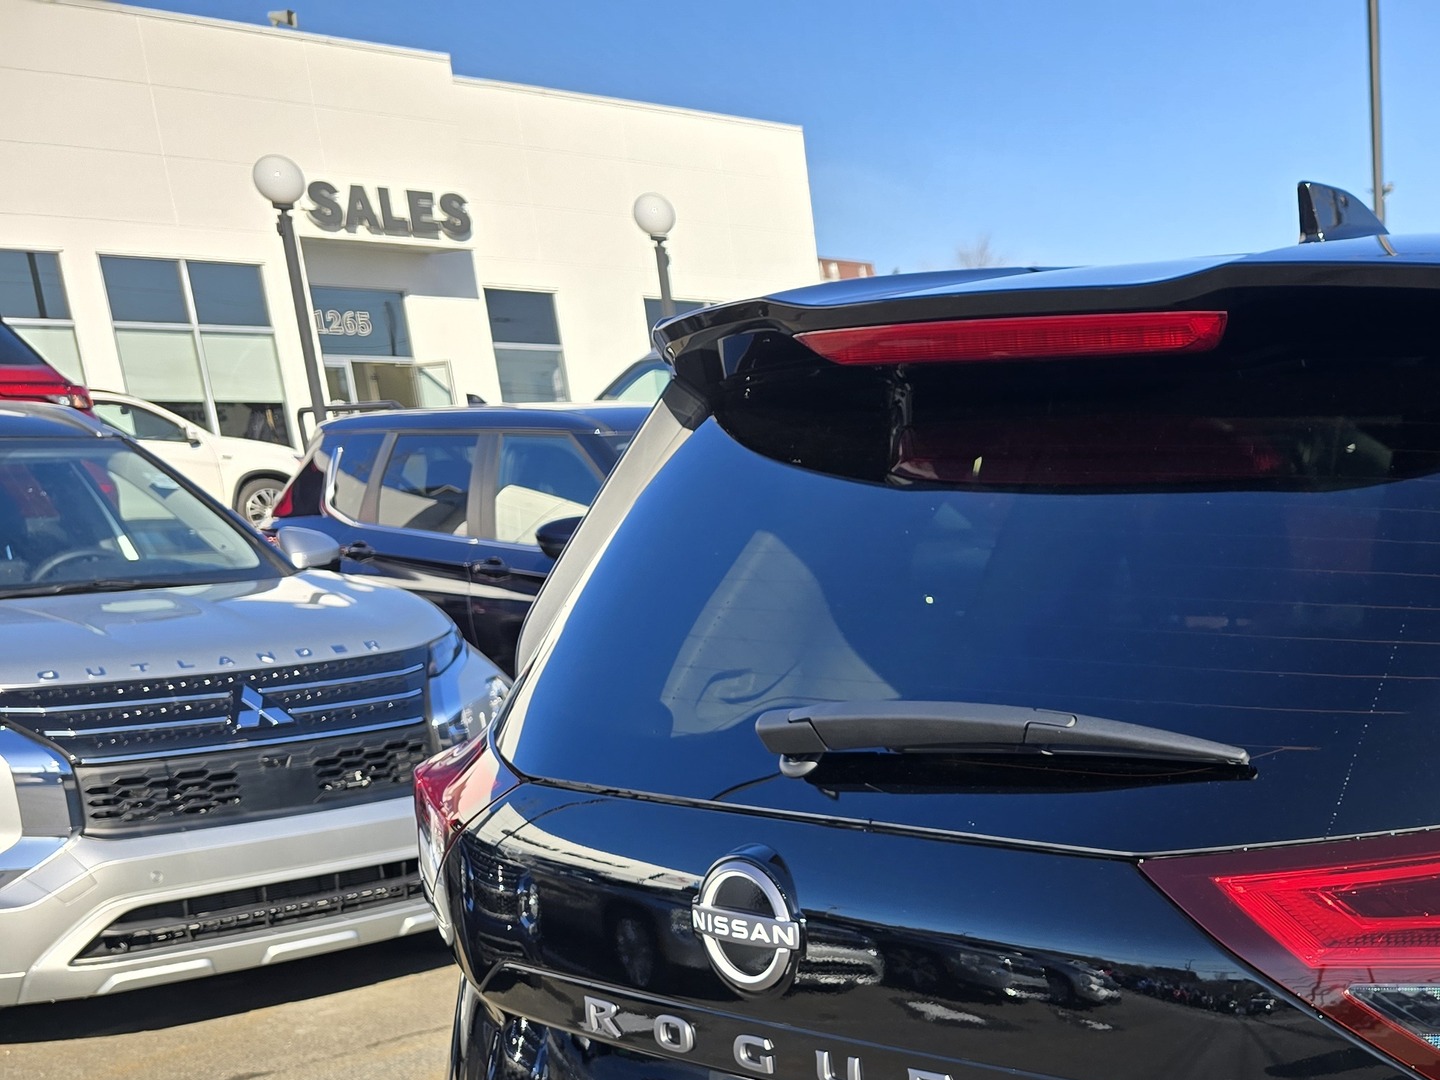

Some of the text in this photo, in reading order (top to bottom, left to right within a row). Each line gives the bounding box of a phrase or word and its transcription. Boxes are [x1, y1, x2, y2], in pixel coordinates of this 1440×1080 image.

[307, 180, 473, 242] SALES
[313, 309, 373, 336] 1265
[36, 639, 382, 680] OUTLANDER
[692, 908, 796, 947] NISSAN
